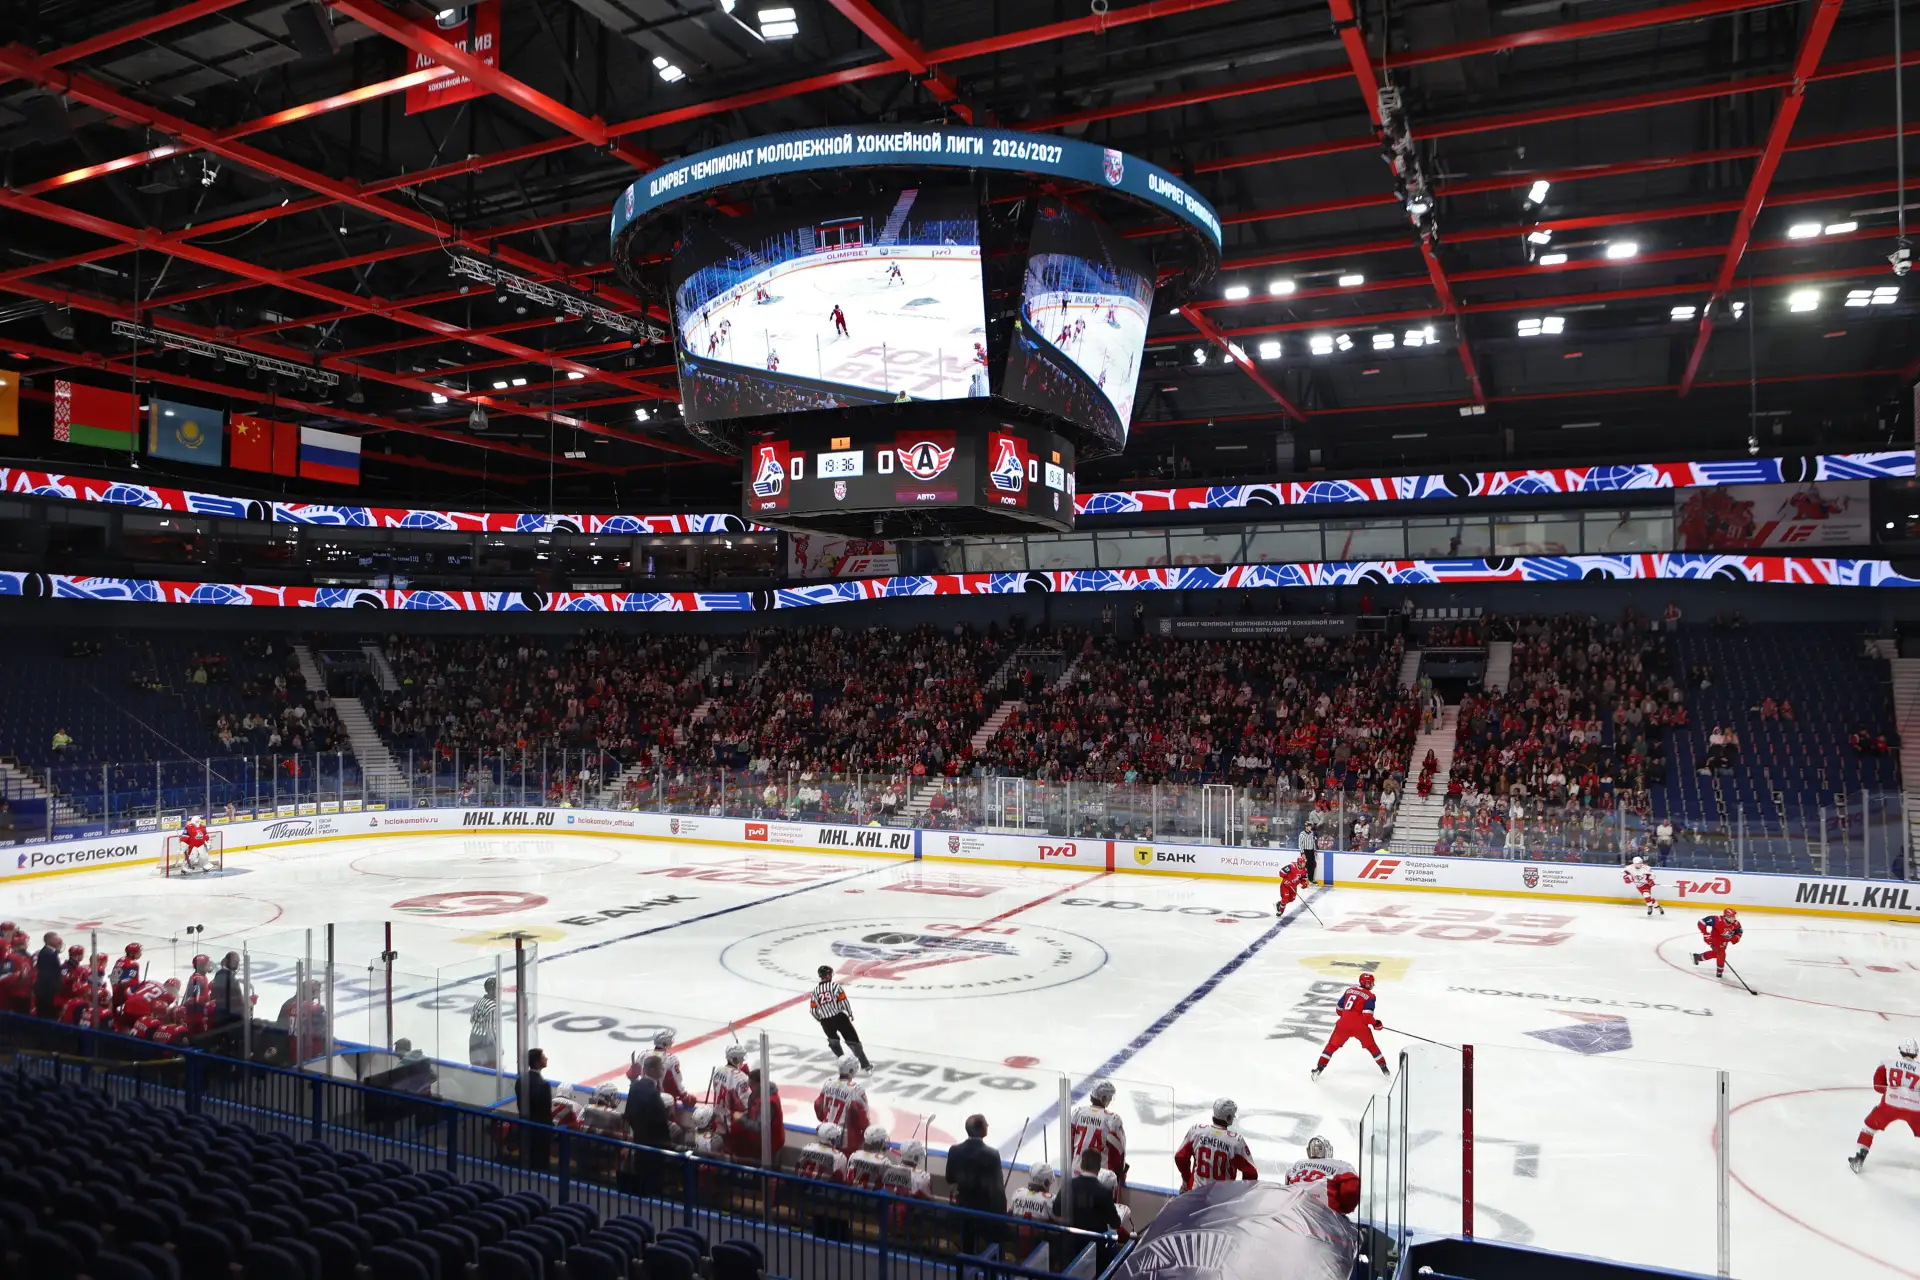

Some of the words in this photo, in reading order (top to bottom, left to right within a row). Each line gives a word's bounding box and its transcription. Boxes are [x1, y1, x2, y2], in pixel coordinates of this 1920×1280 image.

[650, 166, 690, 198] OLIMPBET
[690, 149, 754, 181] ЧЕМПИОНАТ
[757, 133, 853, 165] МОЛОДЕЖНОЙ
[856, 132, 942, 153] ХОККЕЙНОЙ
[945, 136, 984, 155] ЛИГИ
[992, 138, 1063, 164] 2026/2027
[1148, 173, 1184, 206] OLIMPBET
[826, 249, 869, 260] OLIMPBET
[790, 457, 804, 481] 0
[824, 457, 855, 473] 19:36
[877, 450, 894, 475] 0
[1028, 459, 1038, 483] 0
[916, 493, 936, 501] АВТО
[384, 817, 439, 825] hclokomotiv.ru
[462, 812, 555, 827] MHL.KHL.RU
[577, 817, 635, 827] hclokomotiv_official
[25, 836, 46, 844] согаз
[818, 828, 911, 850] MHL.KHL.RU
[31, 845, 138, 867] Ростелеком
[1156, 852, 1196, 864] БАНК
[1220, 857, 1239, 865] РЖД
[1239, 858, 1279, 867] Логистика
[1405, 860, 1449, 869] Федеральная
[1405, 868, 1434, 876] грузовая
[557, 894, 701, 926] БАНК
[1326, 918, 1577, 947] FON
[818, 991, 832, 1004] 29
[1344, 994, 1357, 1010] 6
[1446, 985, 1714, 1018] Ростелеком
[1895, 1060, 1917, 1072] LYKOV
[1888, 1067, 1920, 1092] 87
[1080, 1115, 1102, 1127] IVONIN
[1070, 1122, 1105, 1156] 74
[1199, 1136, 1231, 1152] SEMEIKIN
[1197, 1147, 1228, 1181] 60
[1299, 1162, 1337, 1176] GORBUNOV
